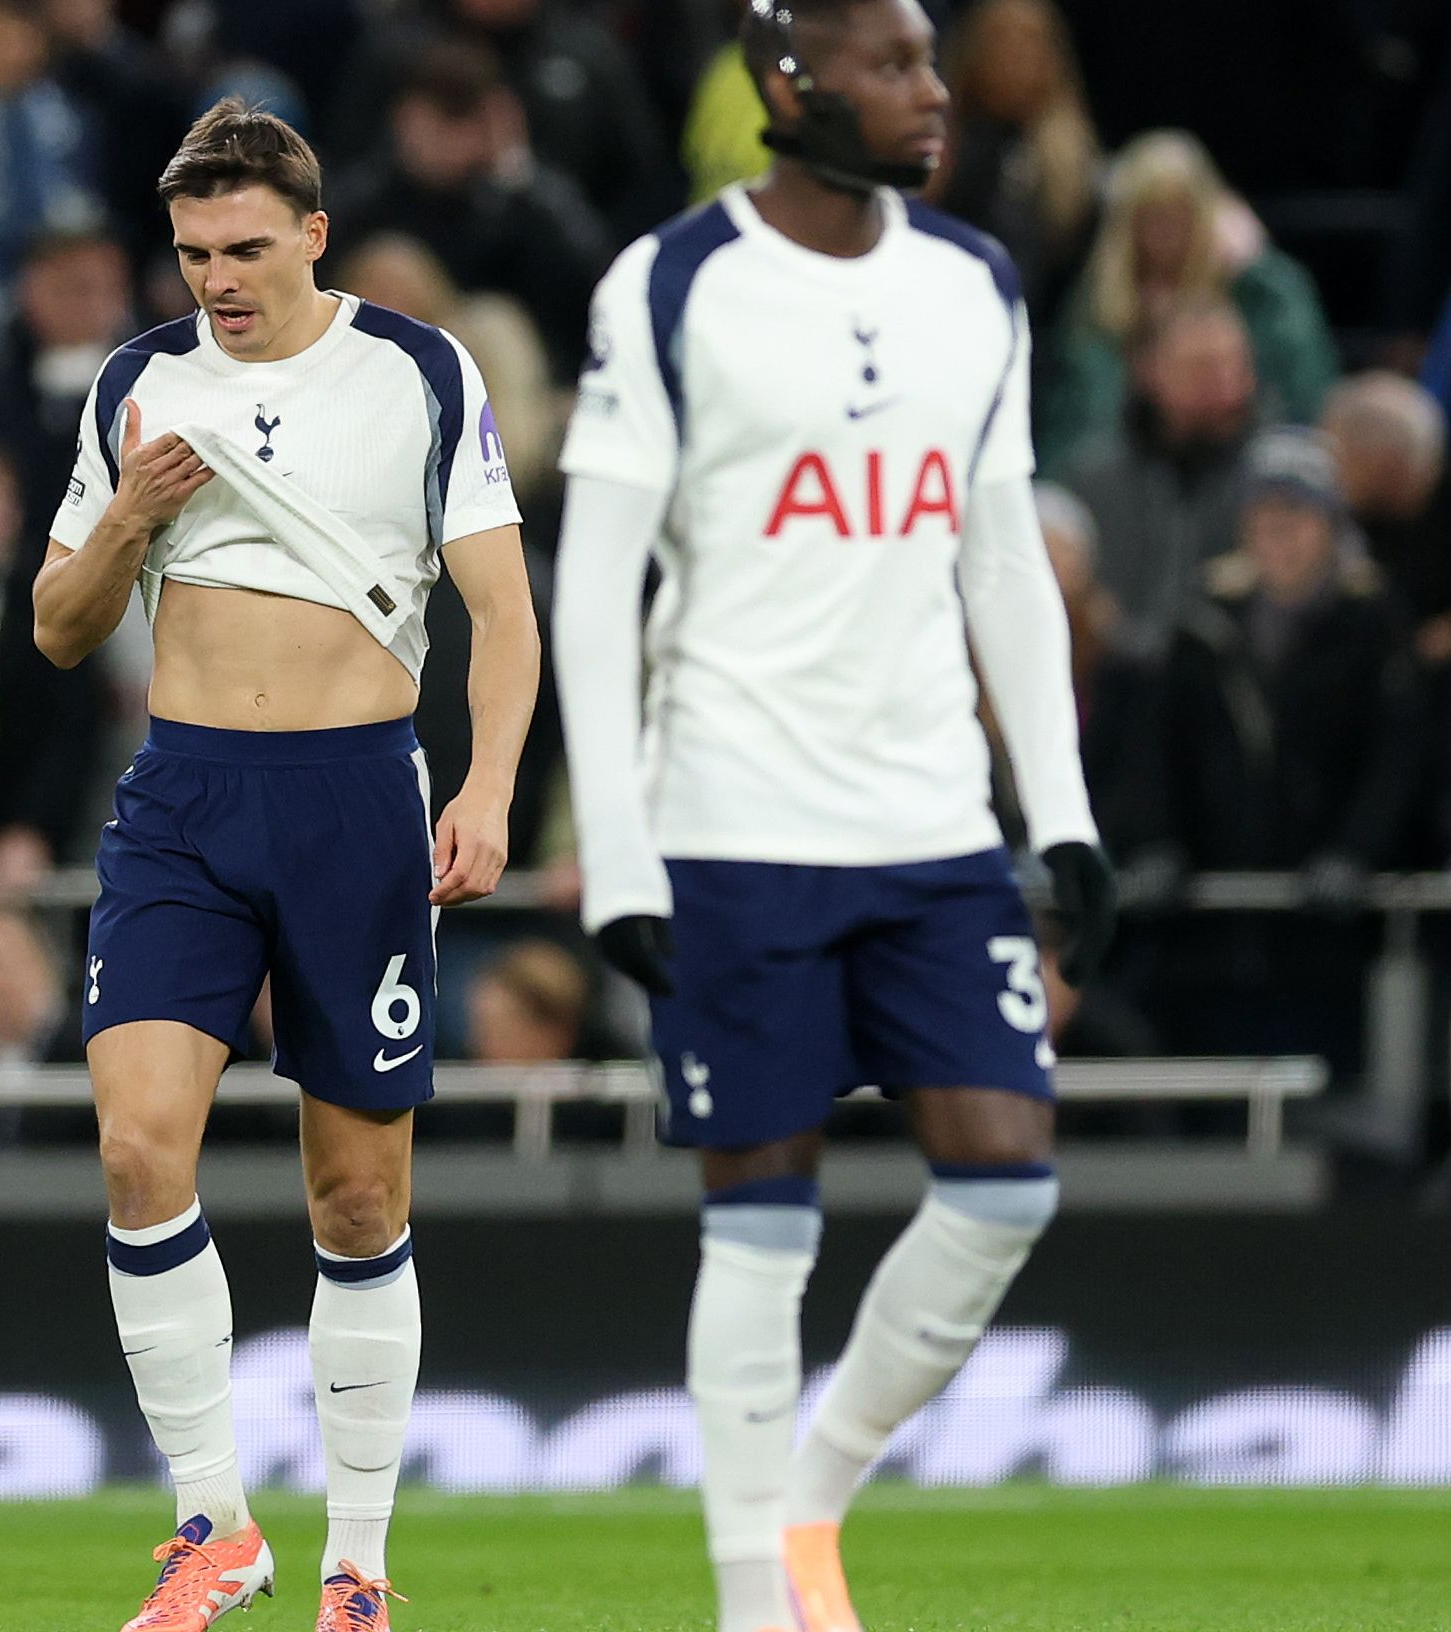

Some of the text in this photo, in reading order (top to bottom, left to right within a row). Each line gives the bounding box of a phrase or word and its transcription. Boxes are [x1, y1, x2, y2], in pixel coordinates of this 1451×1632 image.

[761, 449, 961, 537] AIA
[371, 953, 421, 1040] 6
[986, 935, 1048, 1034] 3
